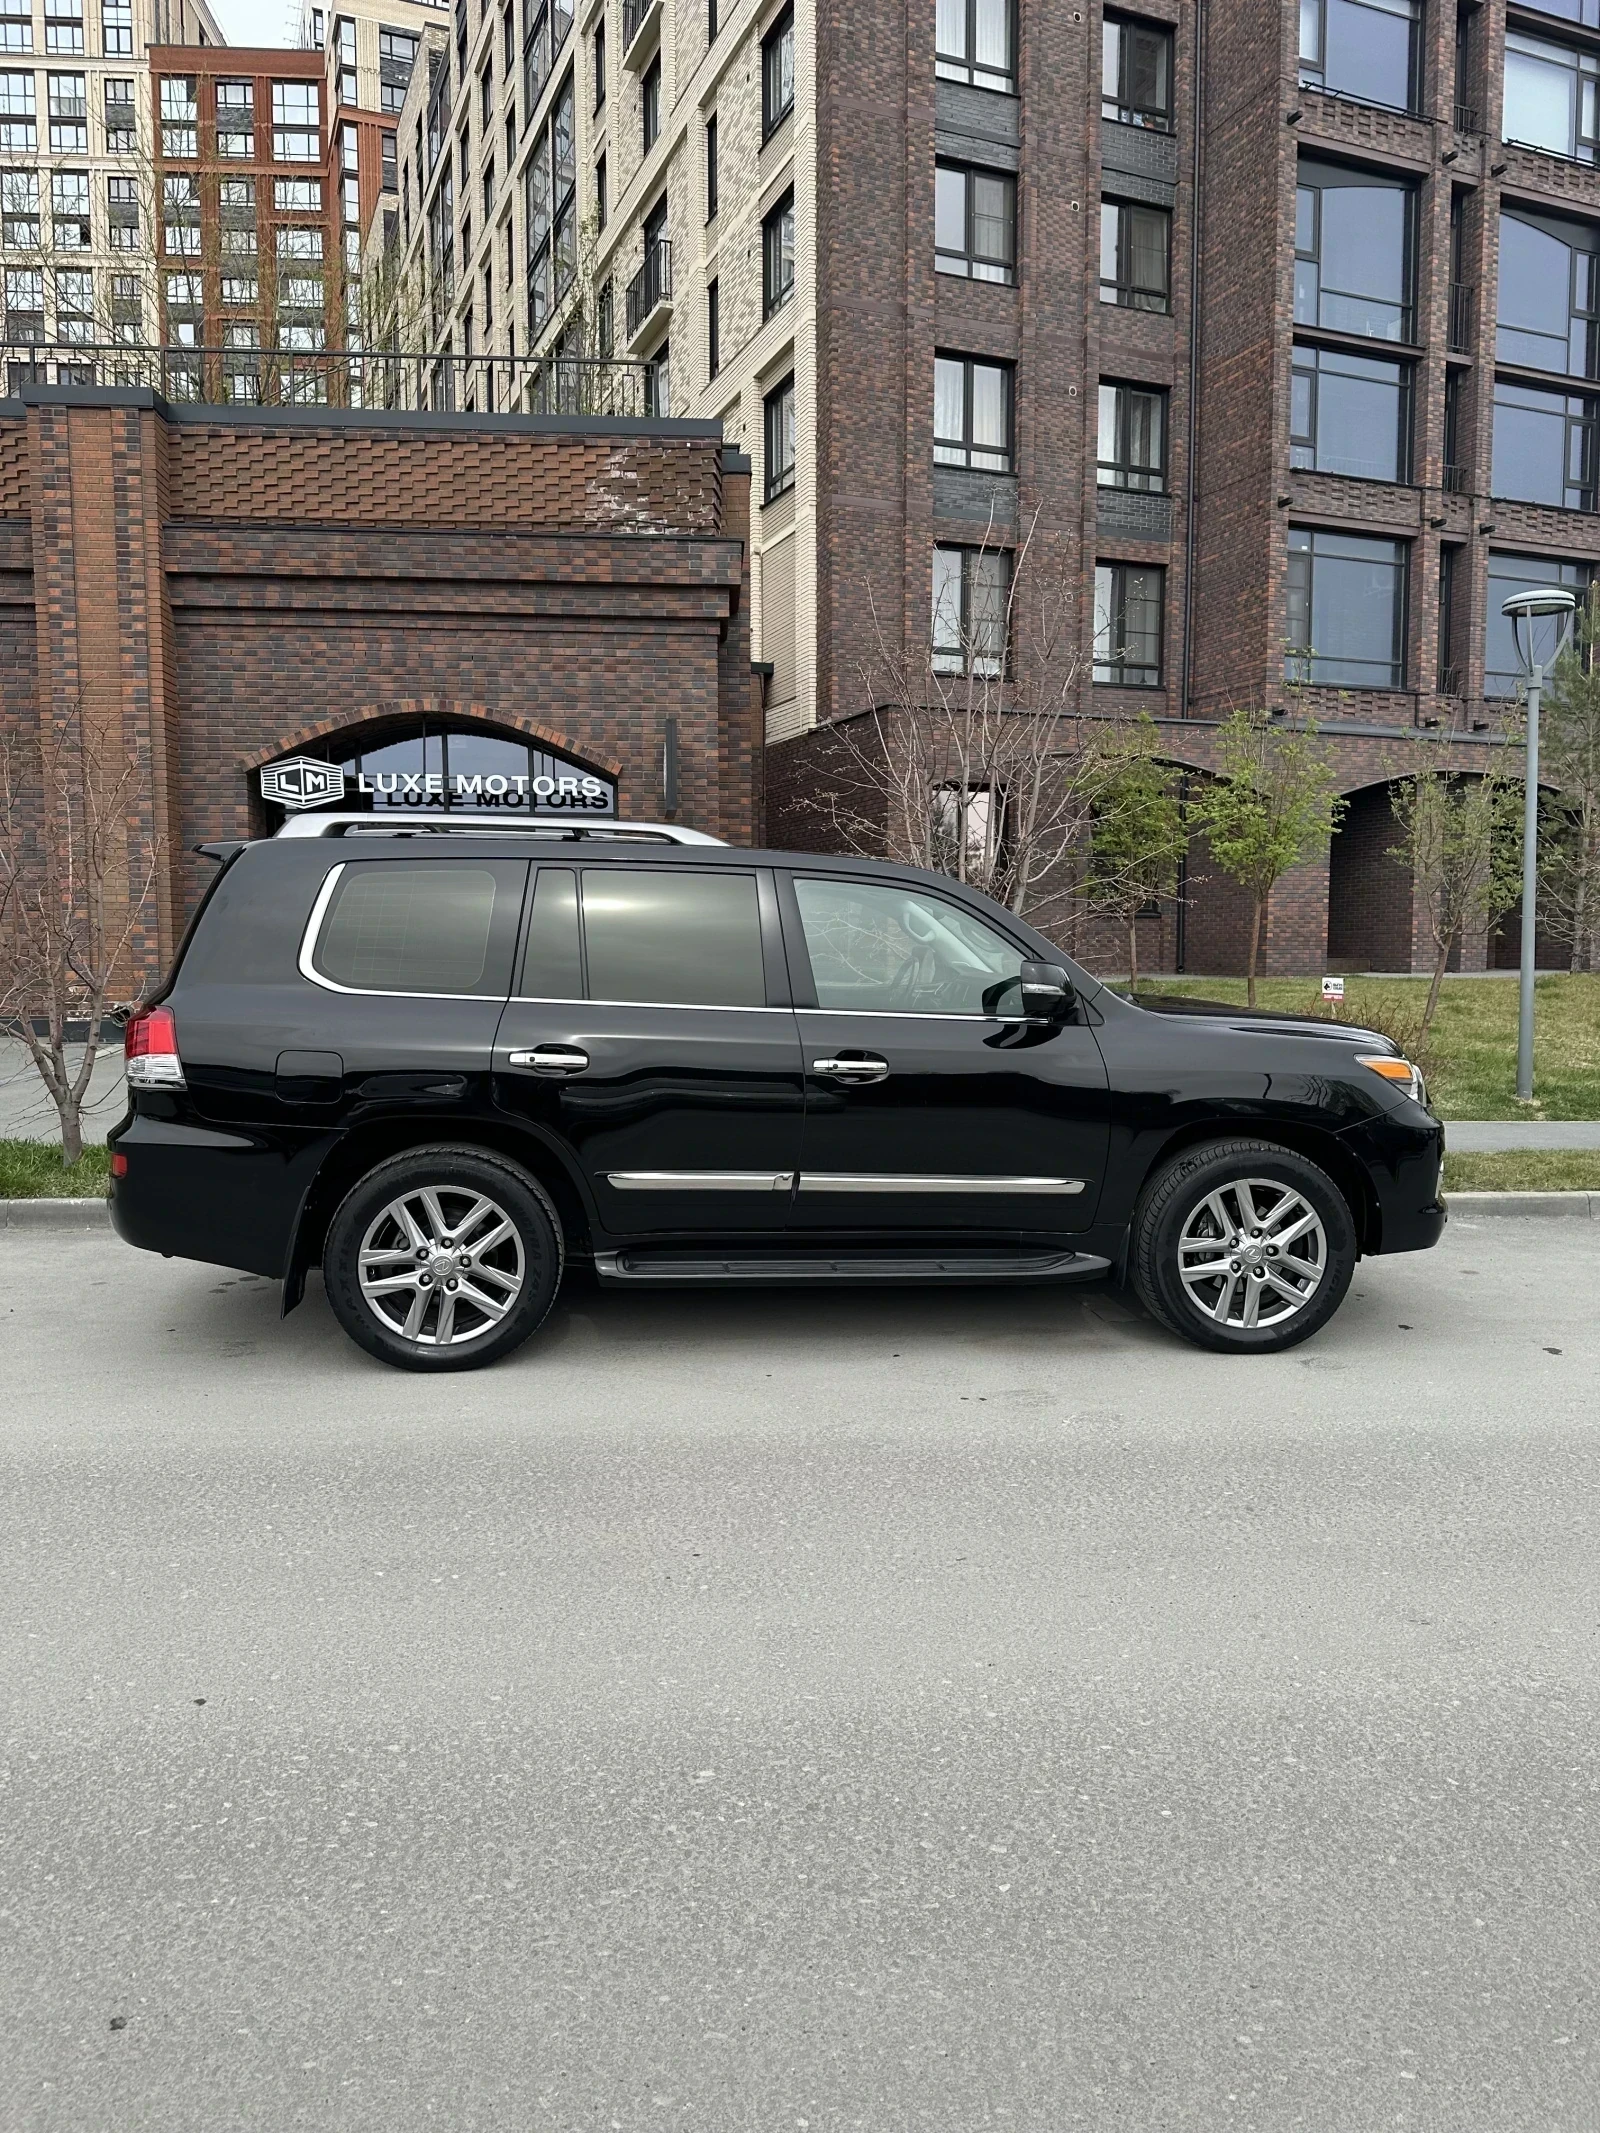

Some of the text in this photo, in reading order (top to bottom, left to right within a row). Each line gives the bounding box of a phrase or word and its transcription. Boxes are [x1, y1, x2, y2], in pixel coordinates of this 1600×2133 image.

[279, 771, 325, 793] LM
[358, 772, 602, 797] LUXE MOTORS
